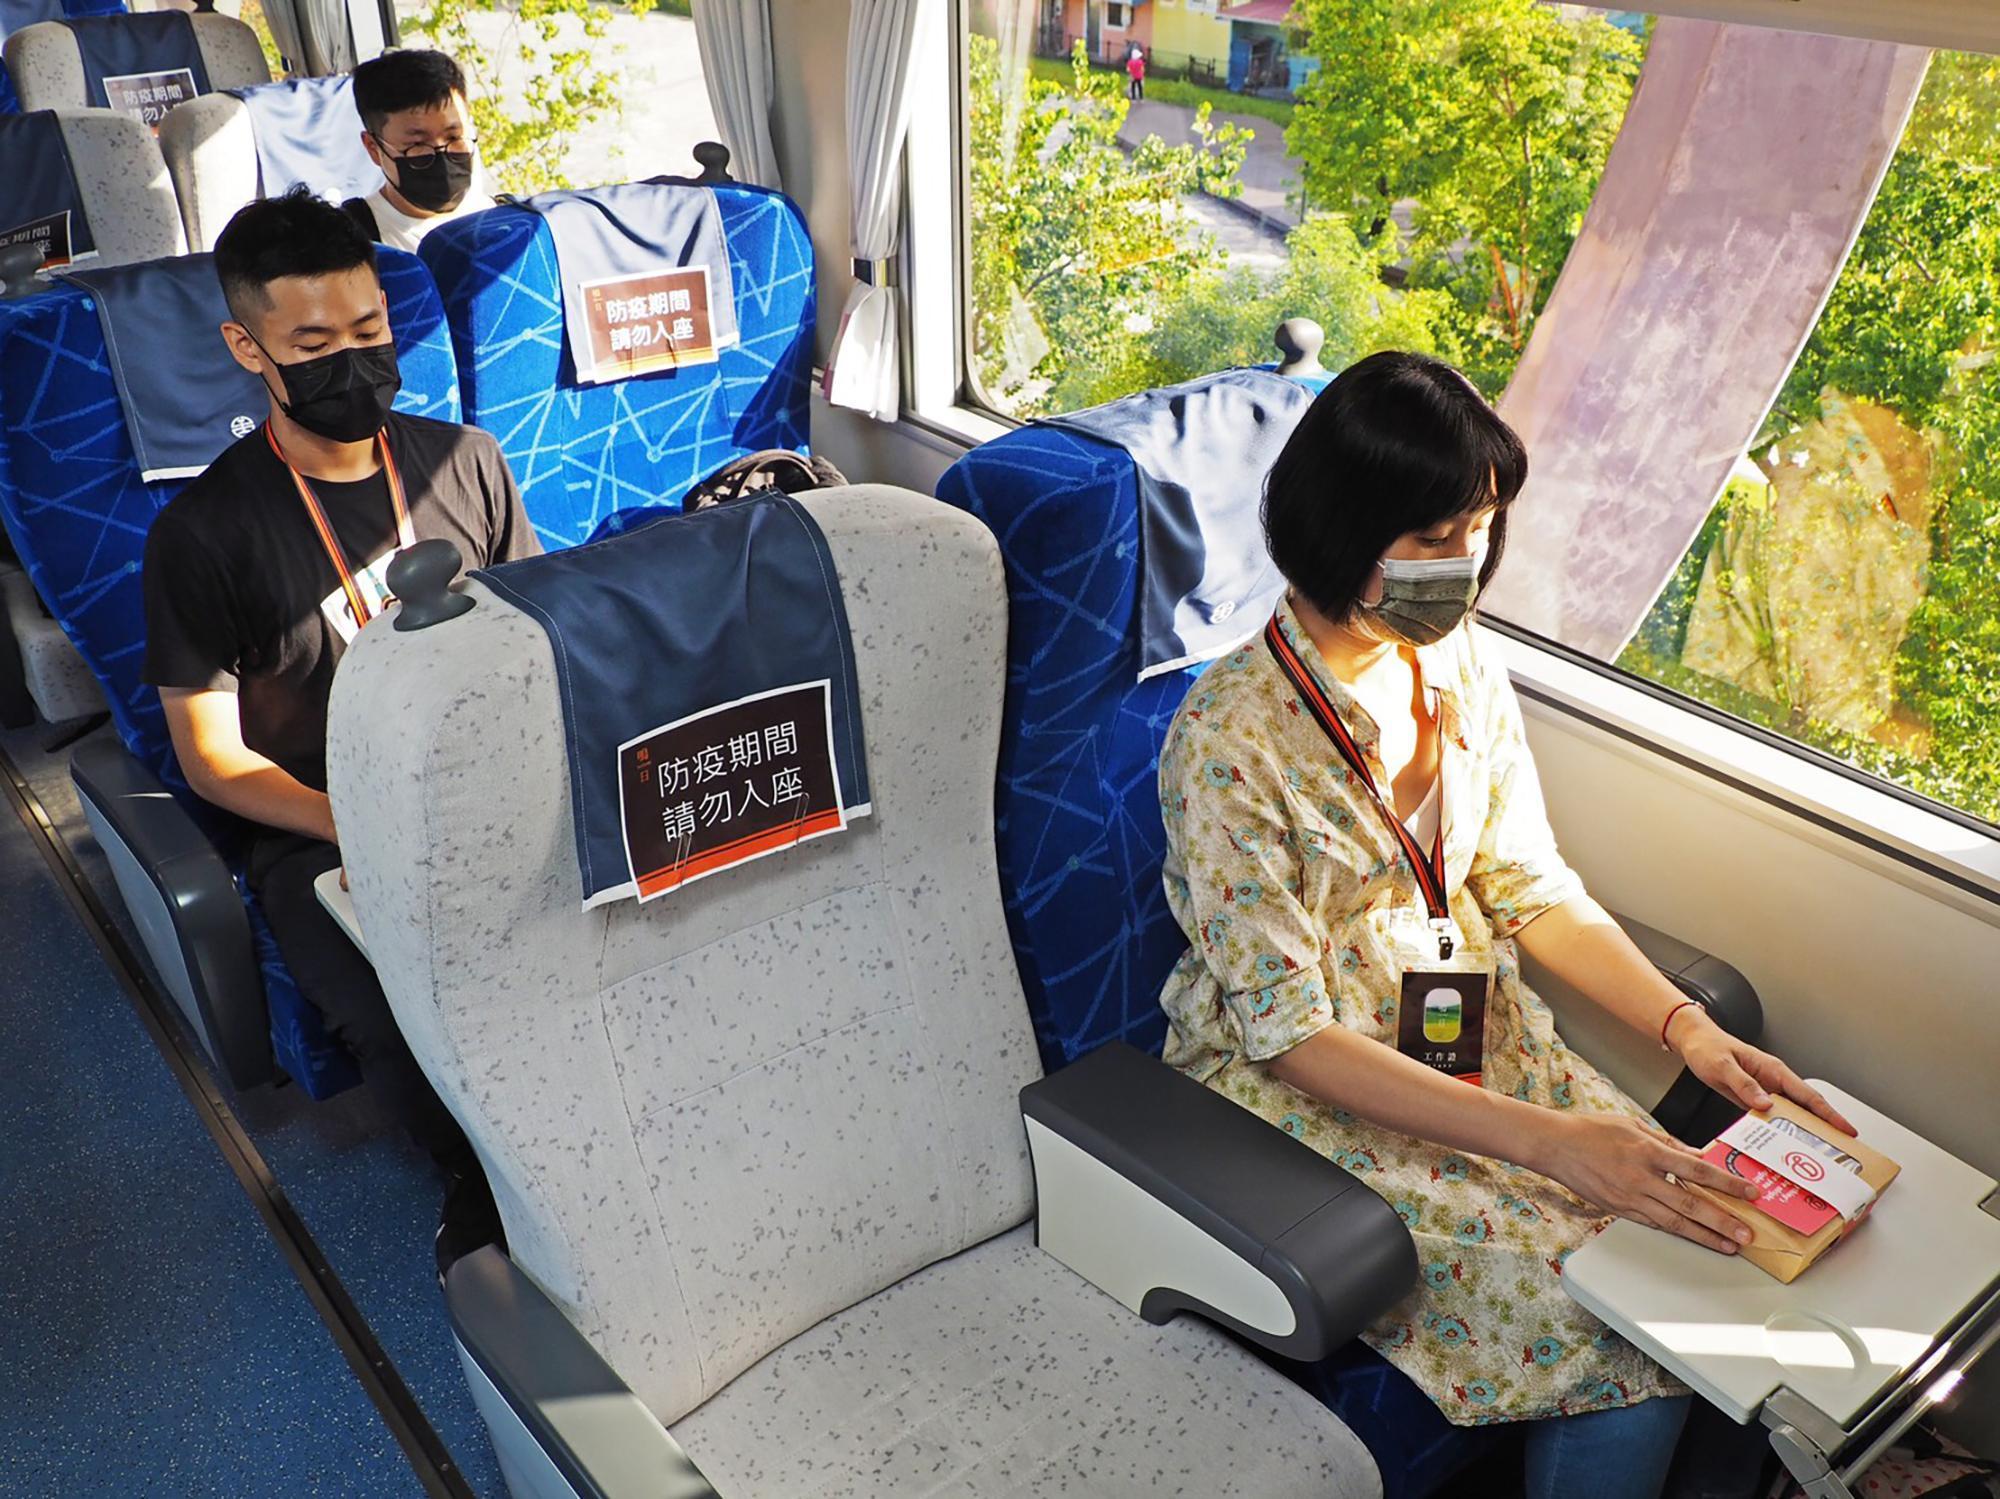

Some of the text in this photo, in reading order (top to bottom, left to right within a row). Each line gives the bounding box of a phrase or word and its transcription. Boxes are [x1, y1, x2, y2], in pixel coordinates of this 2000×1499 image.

[606, 289, 691, 324] 防疫期間
[609, 317, 695, 352] 請勿入座
[657, 721, 798, 798] 防疫期間
[662, 766, 803, 842] 請勿入座
